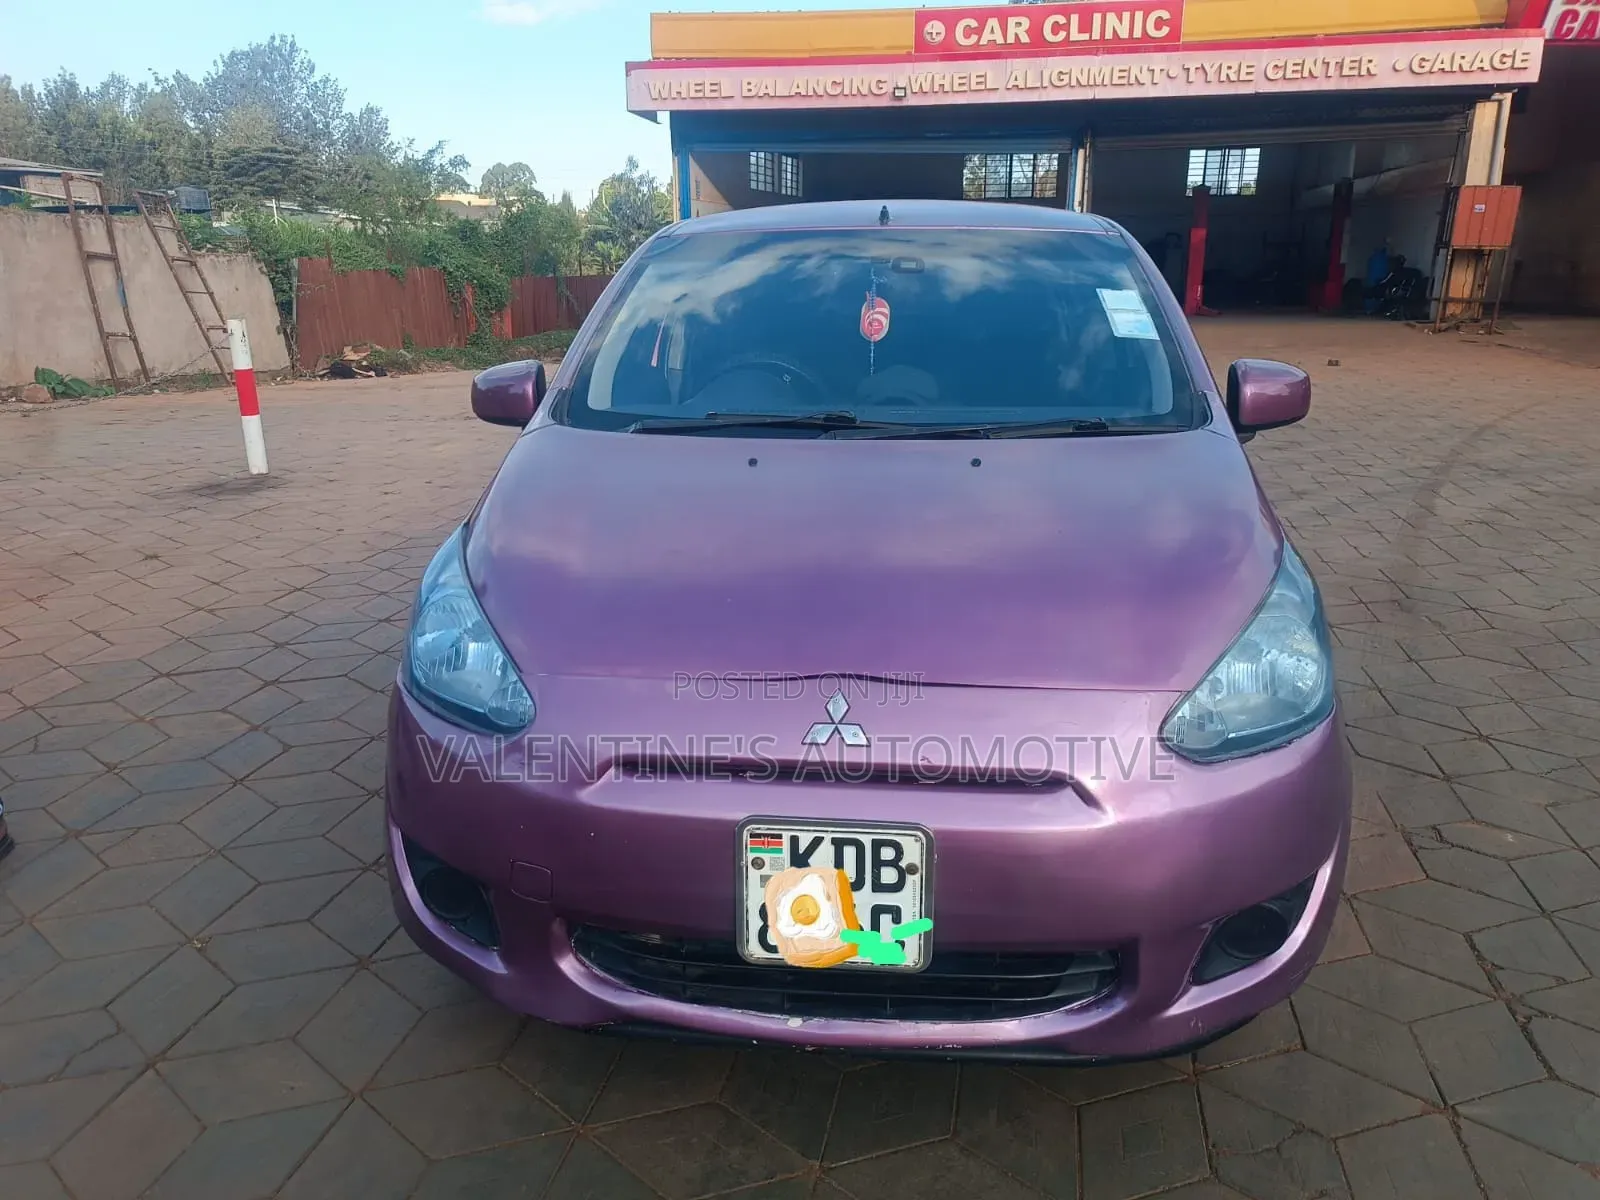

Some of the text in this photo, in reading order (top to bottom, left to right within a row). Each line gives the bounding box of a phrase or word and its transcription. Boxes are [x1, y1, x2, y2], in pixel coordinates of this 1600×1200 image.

[955, 9, 1171, 46] CAR CLINIC
[648, 49, 1530, 100] WHEEL BALANCING WHEEL ALIGNMENT TYRE CENTER GARAGE
